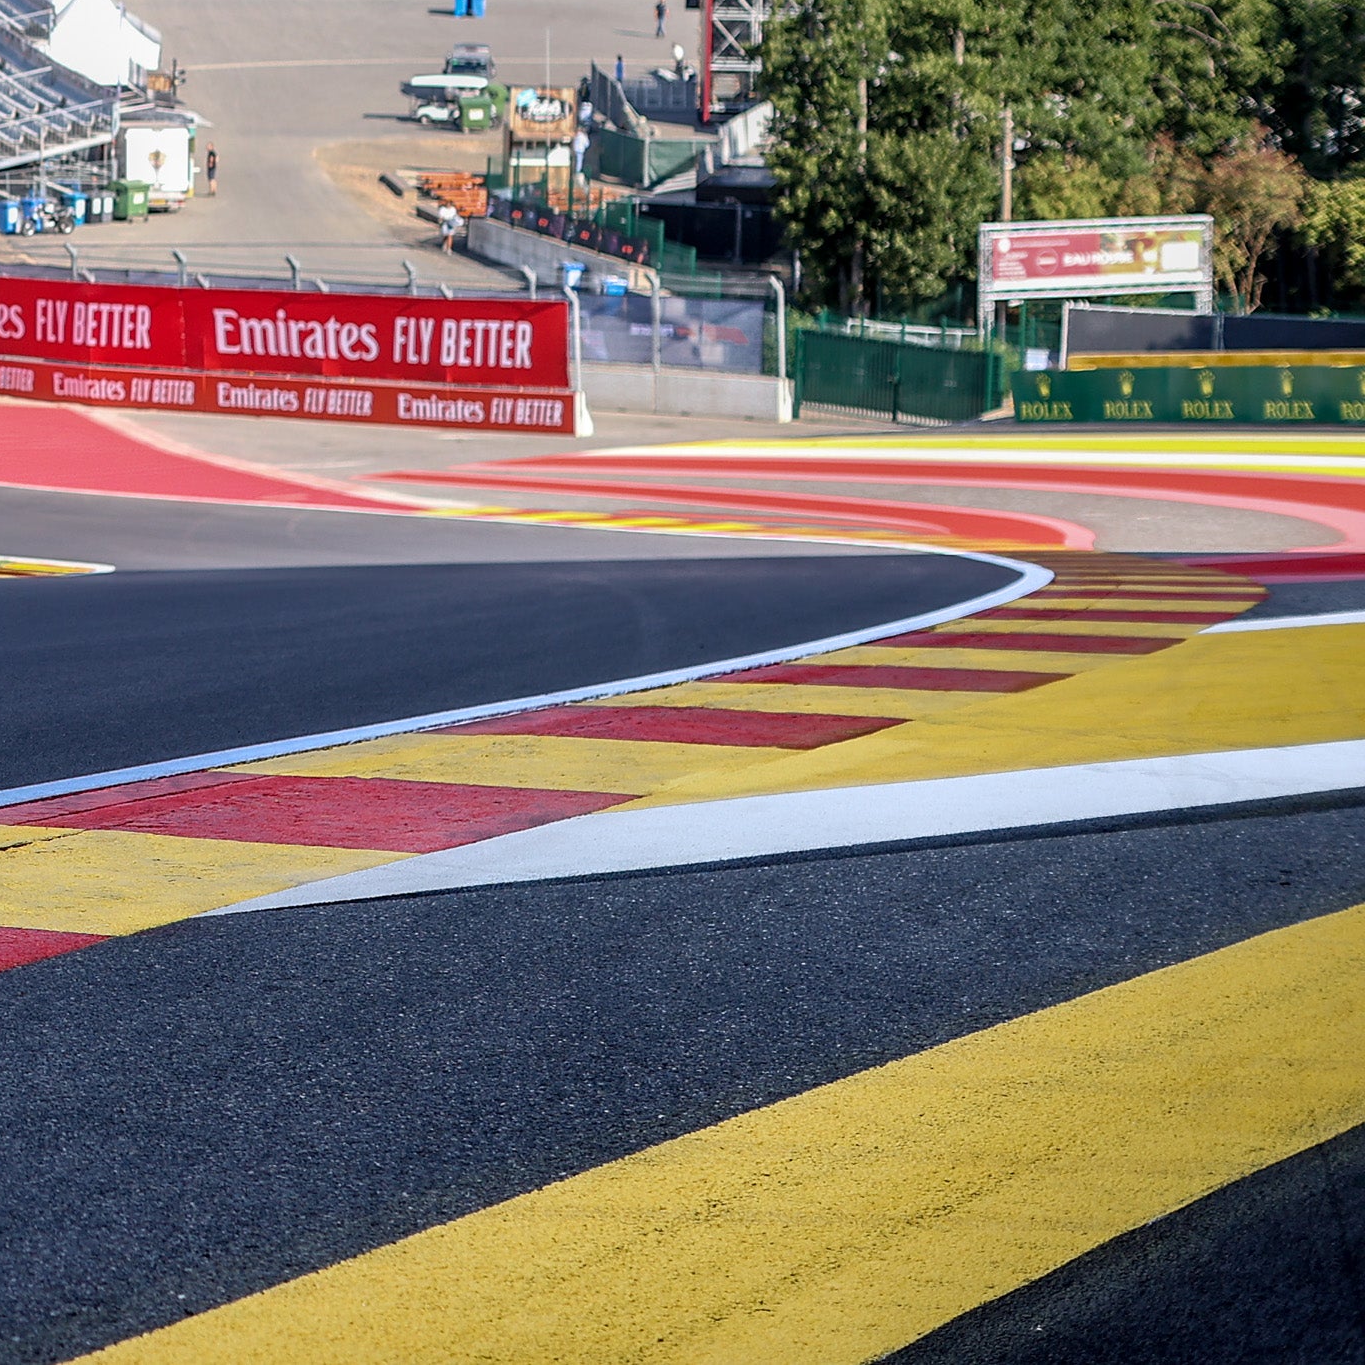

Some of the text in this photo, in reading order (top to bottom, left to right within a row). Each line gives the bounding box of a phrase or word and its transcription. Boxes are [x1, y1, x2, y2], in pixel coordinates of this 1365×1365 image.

[35, 298, 68, 343] FLY
[72, 301, 152, 350] BETTER
[212, 307, 533, 369] Emirates FLY BETTER
[52, 371, 195, 406] Emirates FLY BETTER
[216, 382, 374, 417] Emirates FLY BETTER
[397, 392, 564, 427] Emirates FLY BETTER
[1020, 400, 1074, 421] ROLEX
[1103, 400, 1154, 421] ROLEX
[1182, 400, 1235, 421] ROLEX
[1264, 400, 1316, 421] ROLEX
